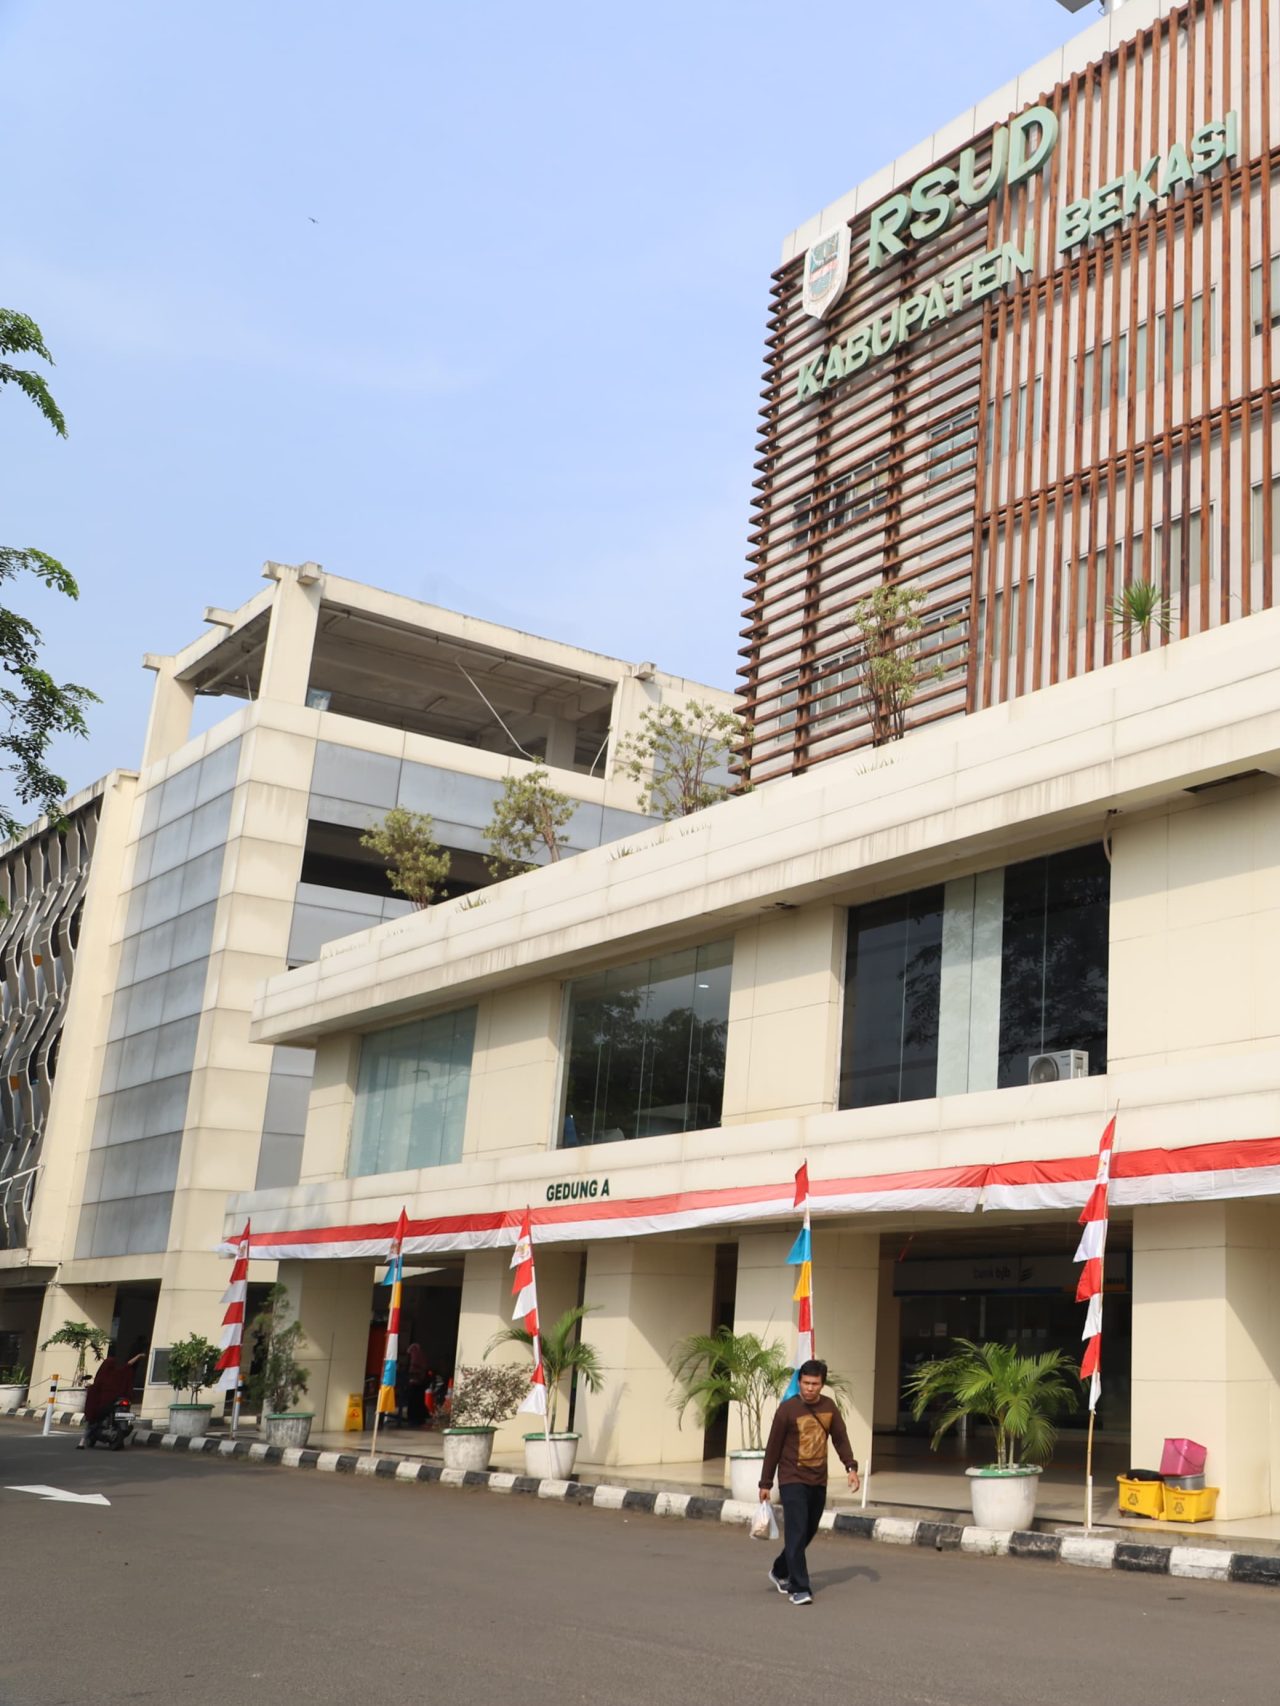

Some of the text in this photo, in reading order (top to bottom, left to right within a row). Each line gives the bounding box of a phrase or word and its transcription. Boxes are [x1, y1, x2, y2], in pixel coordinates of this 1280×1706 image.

[797, 109, 1238, 402] KABUPATEN BEKASI
[868, 105, 1059, 273] RSUD
[546, 1178, 610, 1201] GEDUNG A
